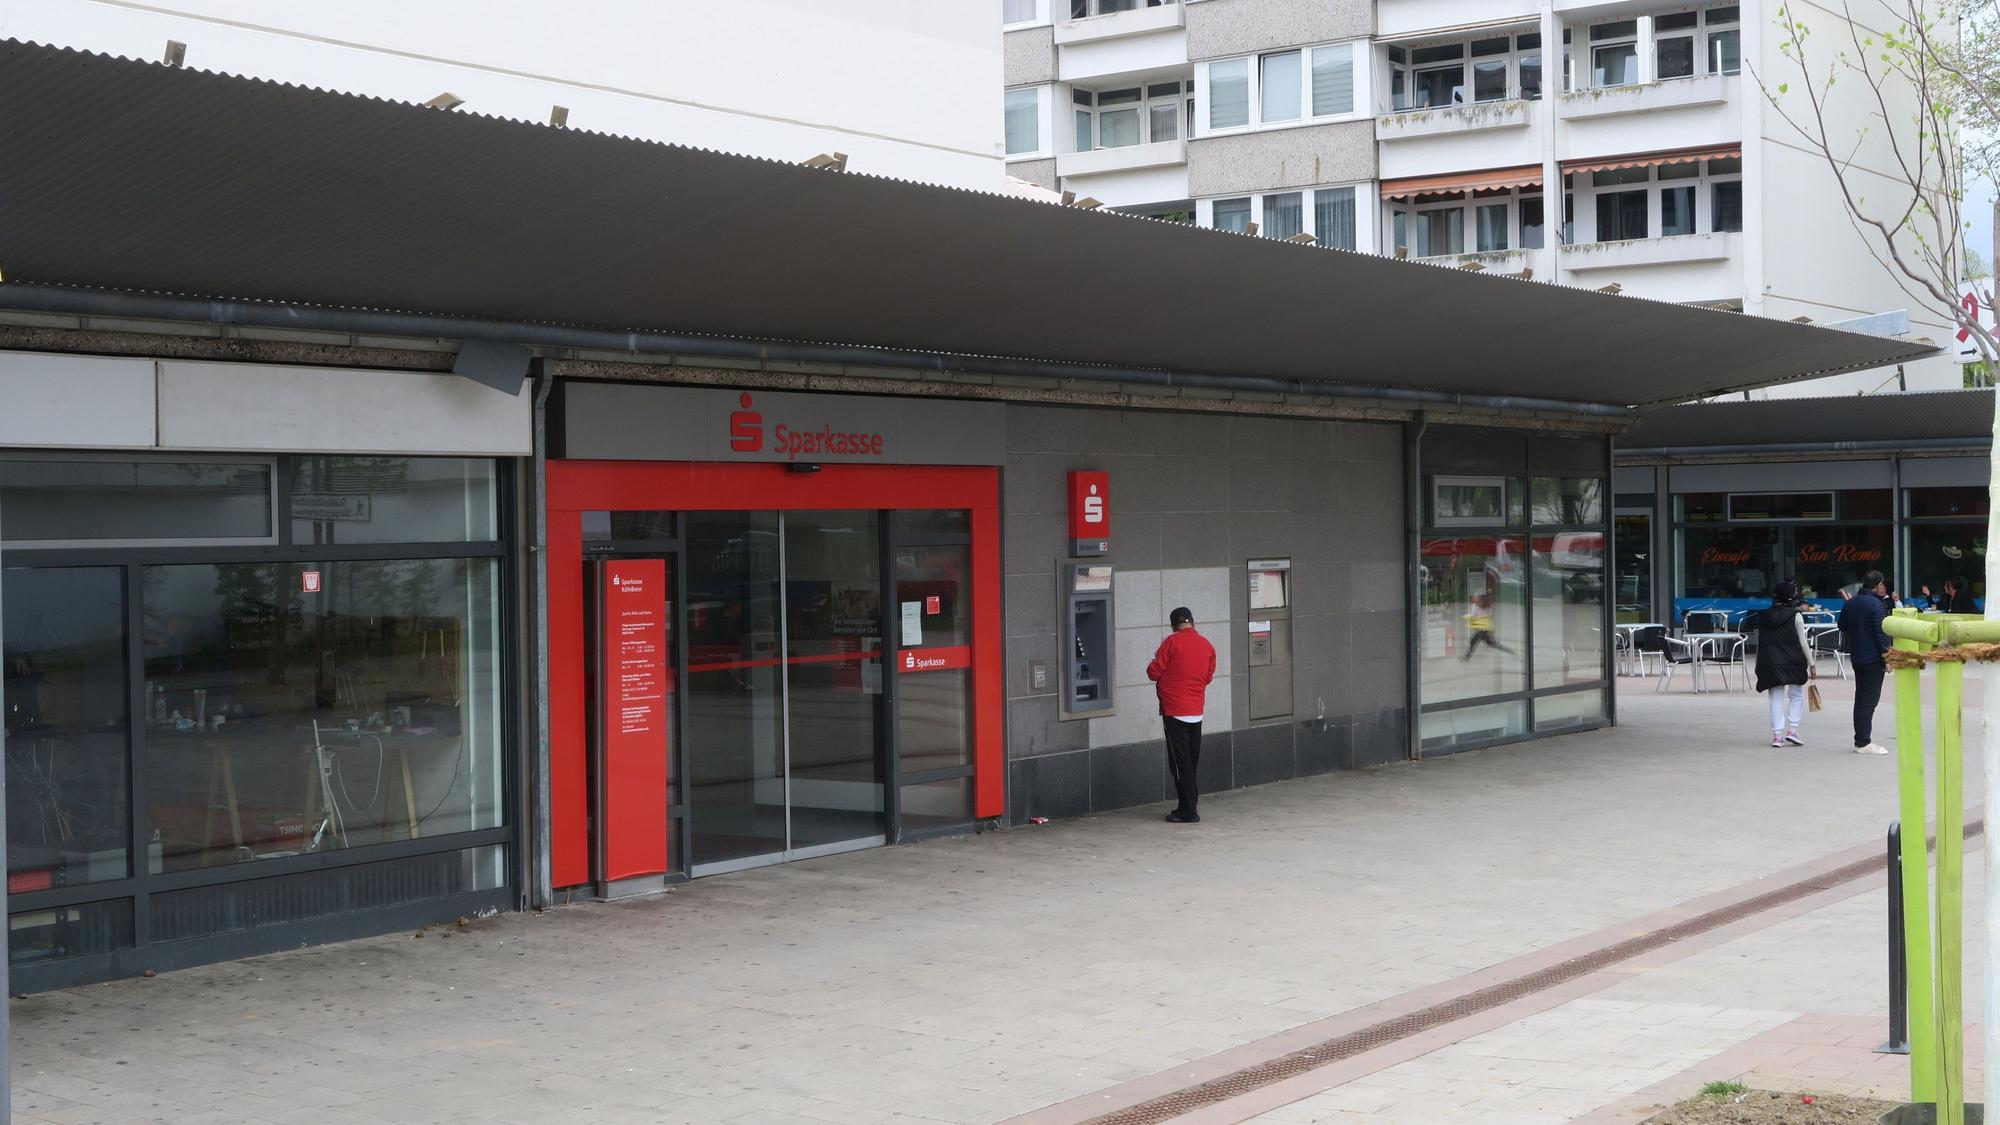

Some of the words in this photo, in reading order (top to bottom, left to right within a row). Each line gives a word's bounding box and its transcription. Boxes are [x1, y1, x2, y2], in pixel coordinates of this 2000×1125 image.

[774, 424, 884, 461] Sparkasse
[1798, 544, 1830, 563] San
[1832, 544, 1881, 563] Remo
[621, 578, 642, 586] Sparkasse
[916, 658, 946, 669] Sparkasse
